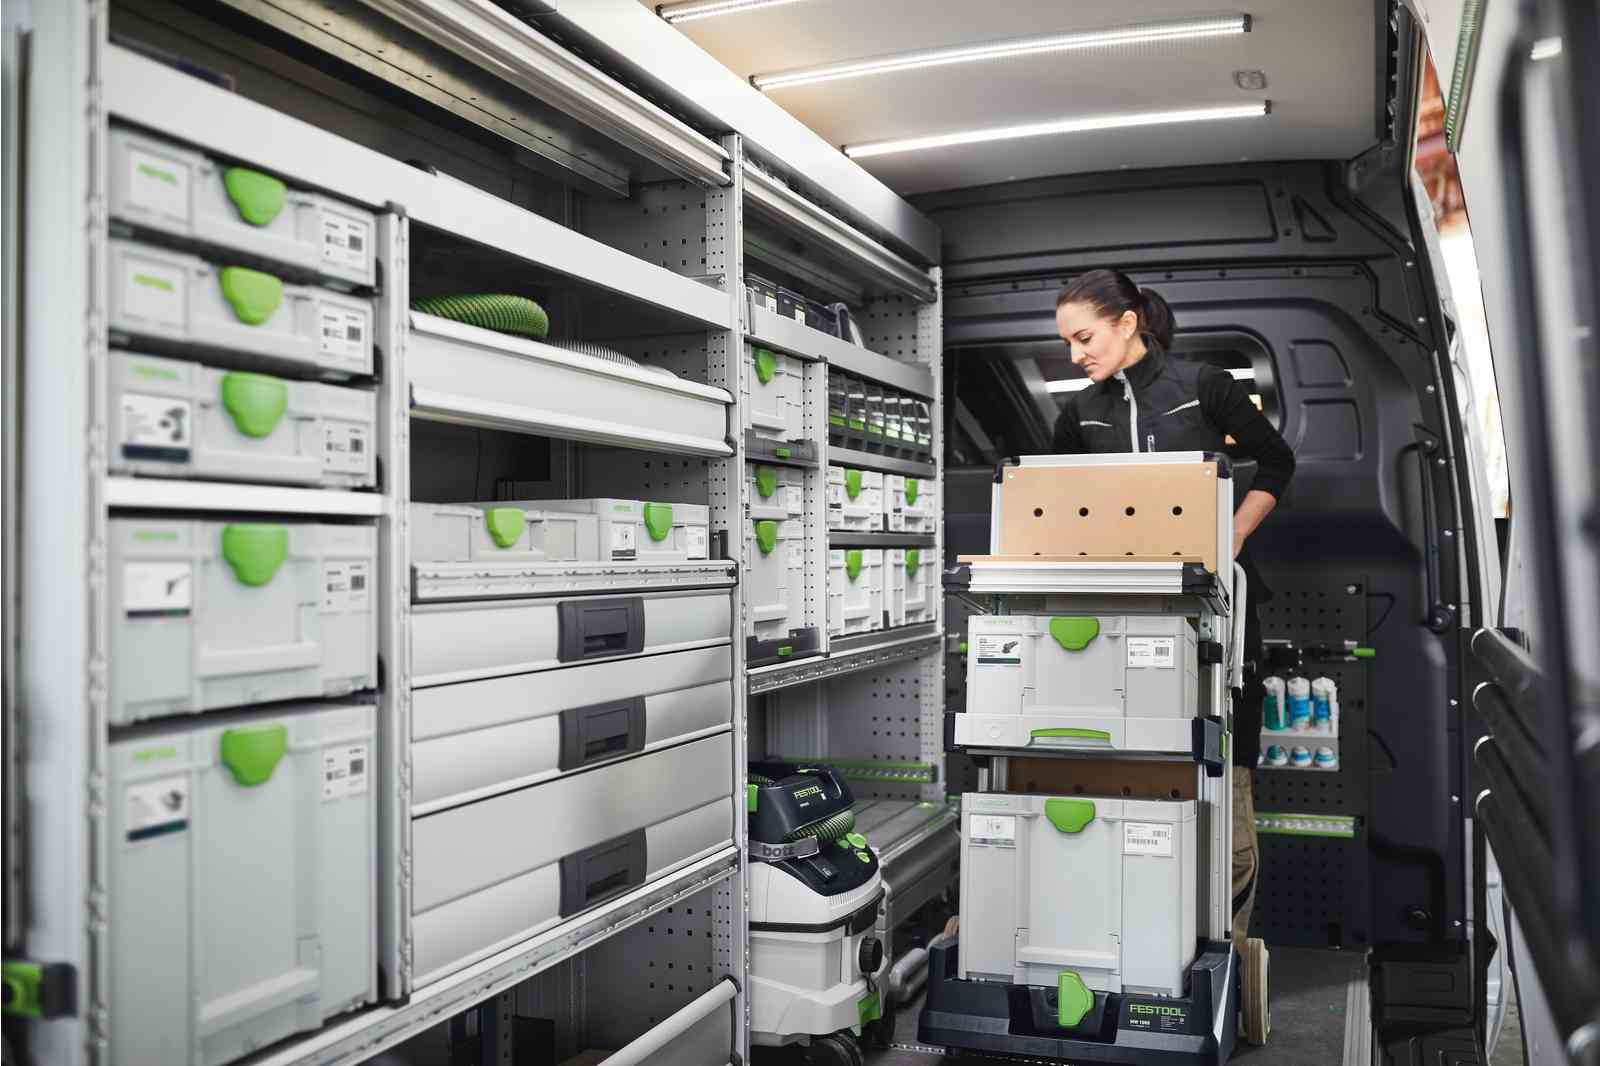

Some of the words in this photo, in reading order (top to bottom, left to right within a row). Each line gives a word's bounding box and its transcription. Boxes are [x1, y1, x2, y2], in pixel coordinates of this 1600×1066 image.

[793, 786, 822, 799] FESTOOL
[762, 845, 794, 857] bott
[1129, 1004, 1186, 1016] FESTOOL
